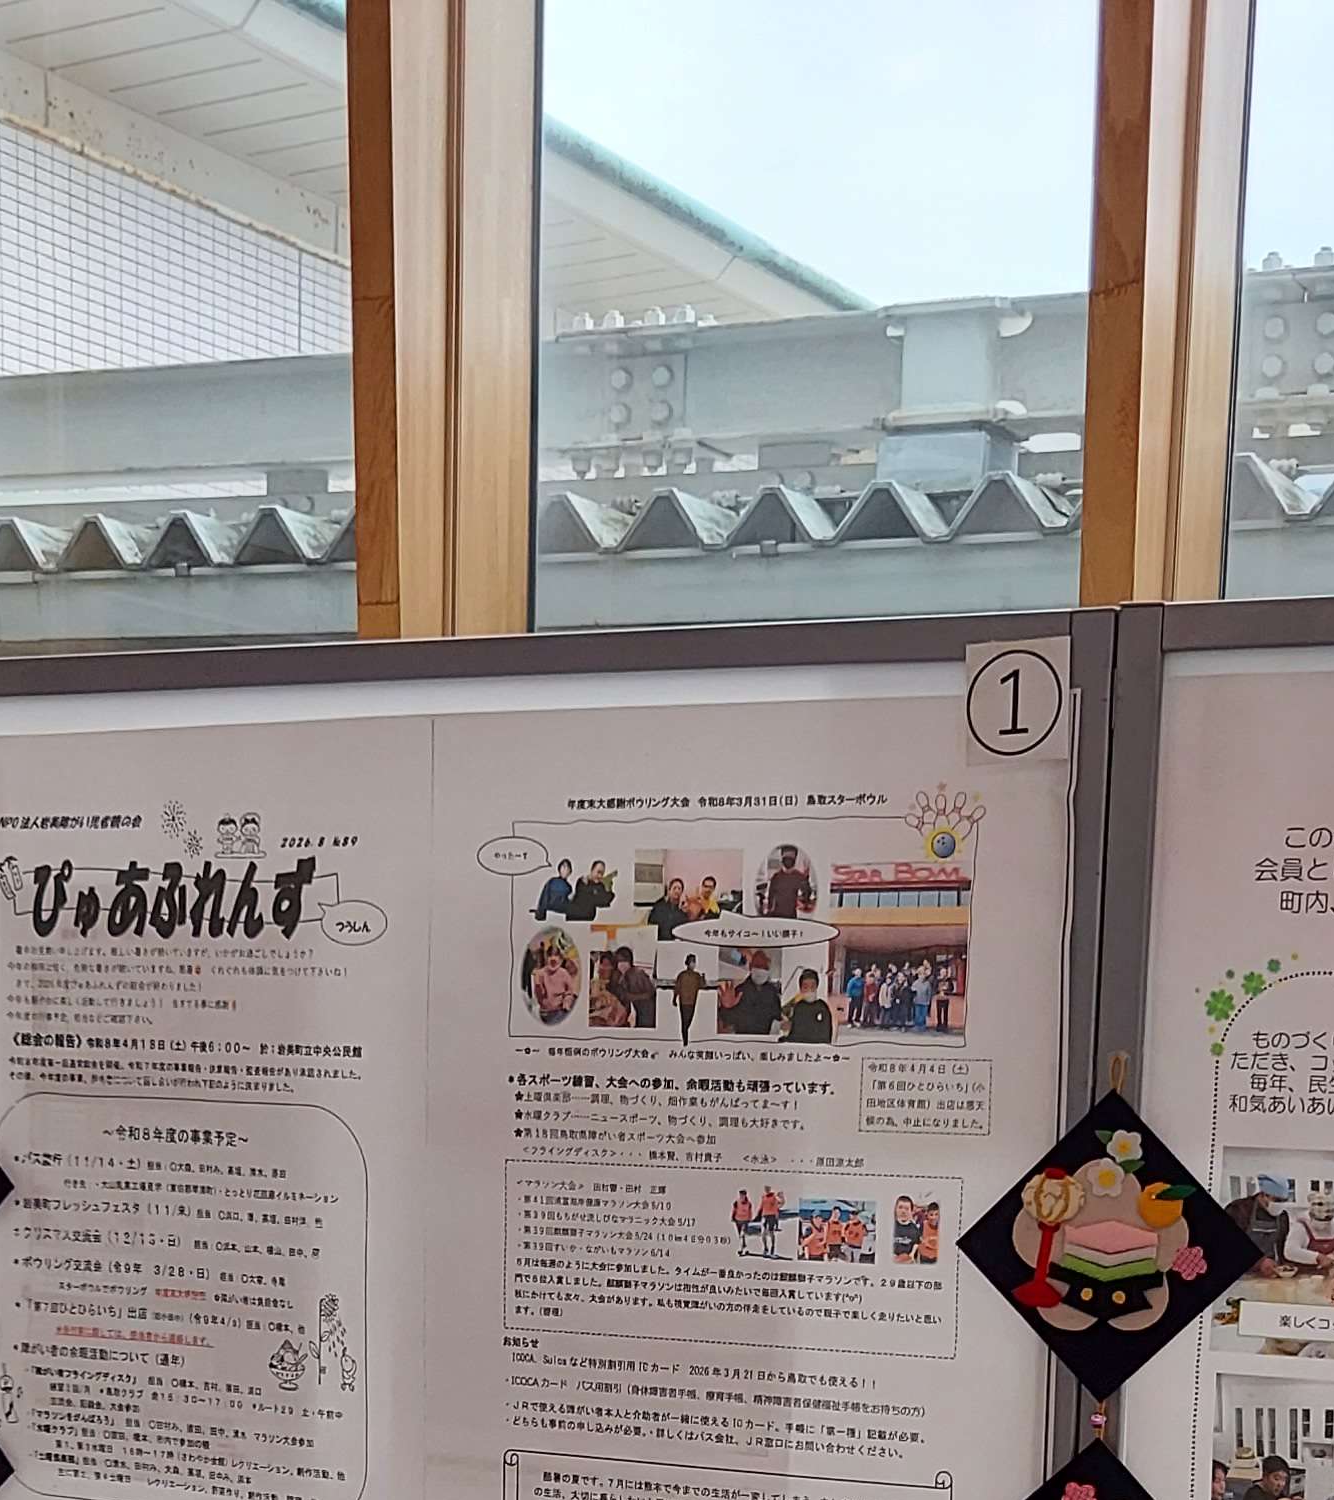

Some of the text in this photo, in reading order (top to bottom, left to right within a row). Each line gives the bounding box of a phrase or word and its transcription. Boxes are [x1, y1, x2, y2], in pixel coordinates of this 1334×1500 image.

[567, 796, 690, 810] 年度末大感謝ボウリング大会
[806, 792, 888, 807] 鳥取スターボウル
[33, 855, 316, 940] ぴゅあふれんず
[335, 920, 371, 934] つうしん
[503, 1336, 540, 1349] お知らせ
